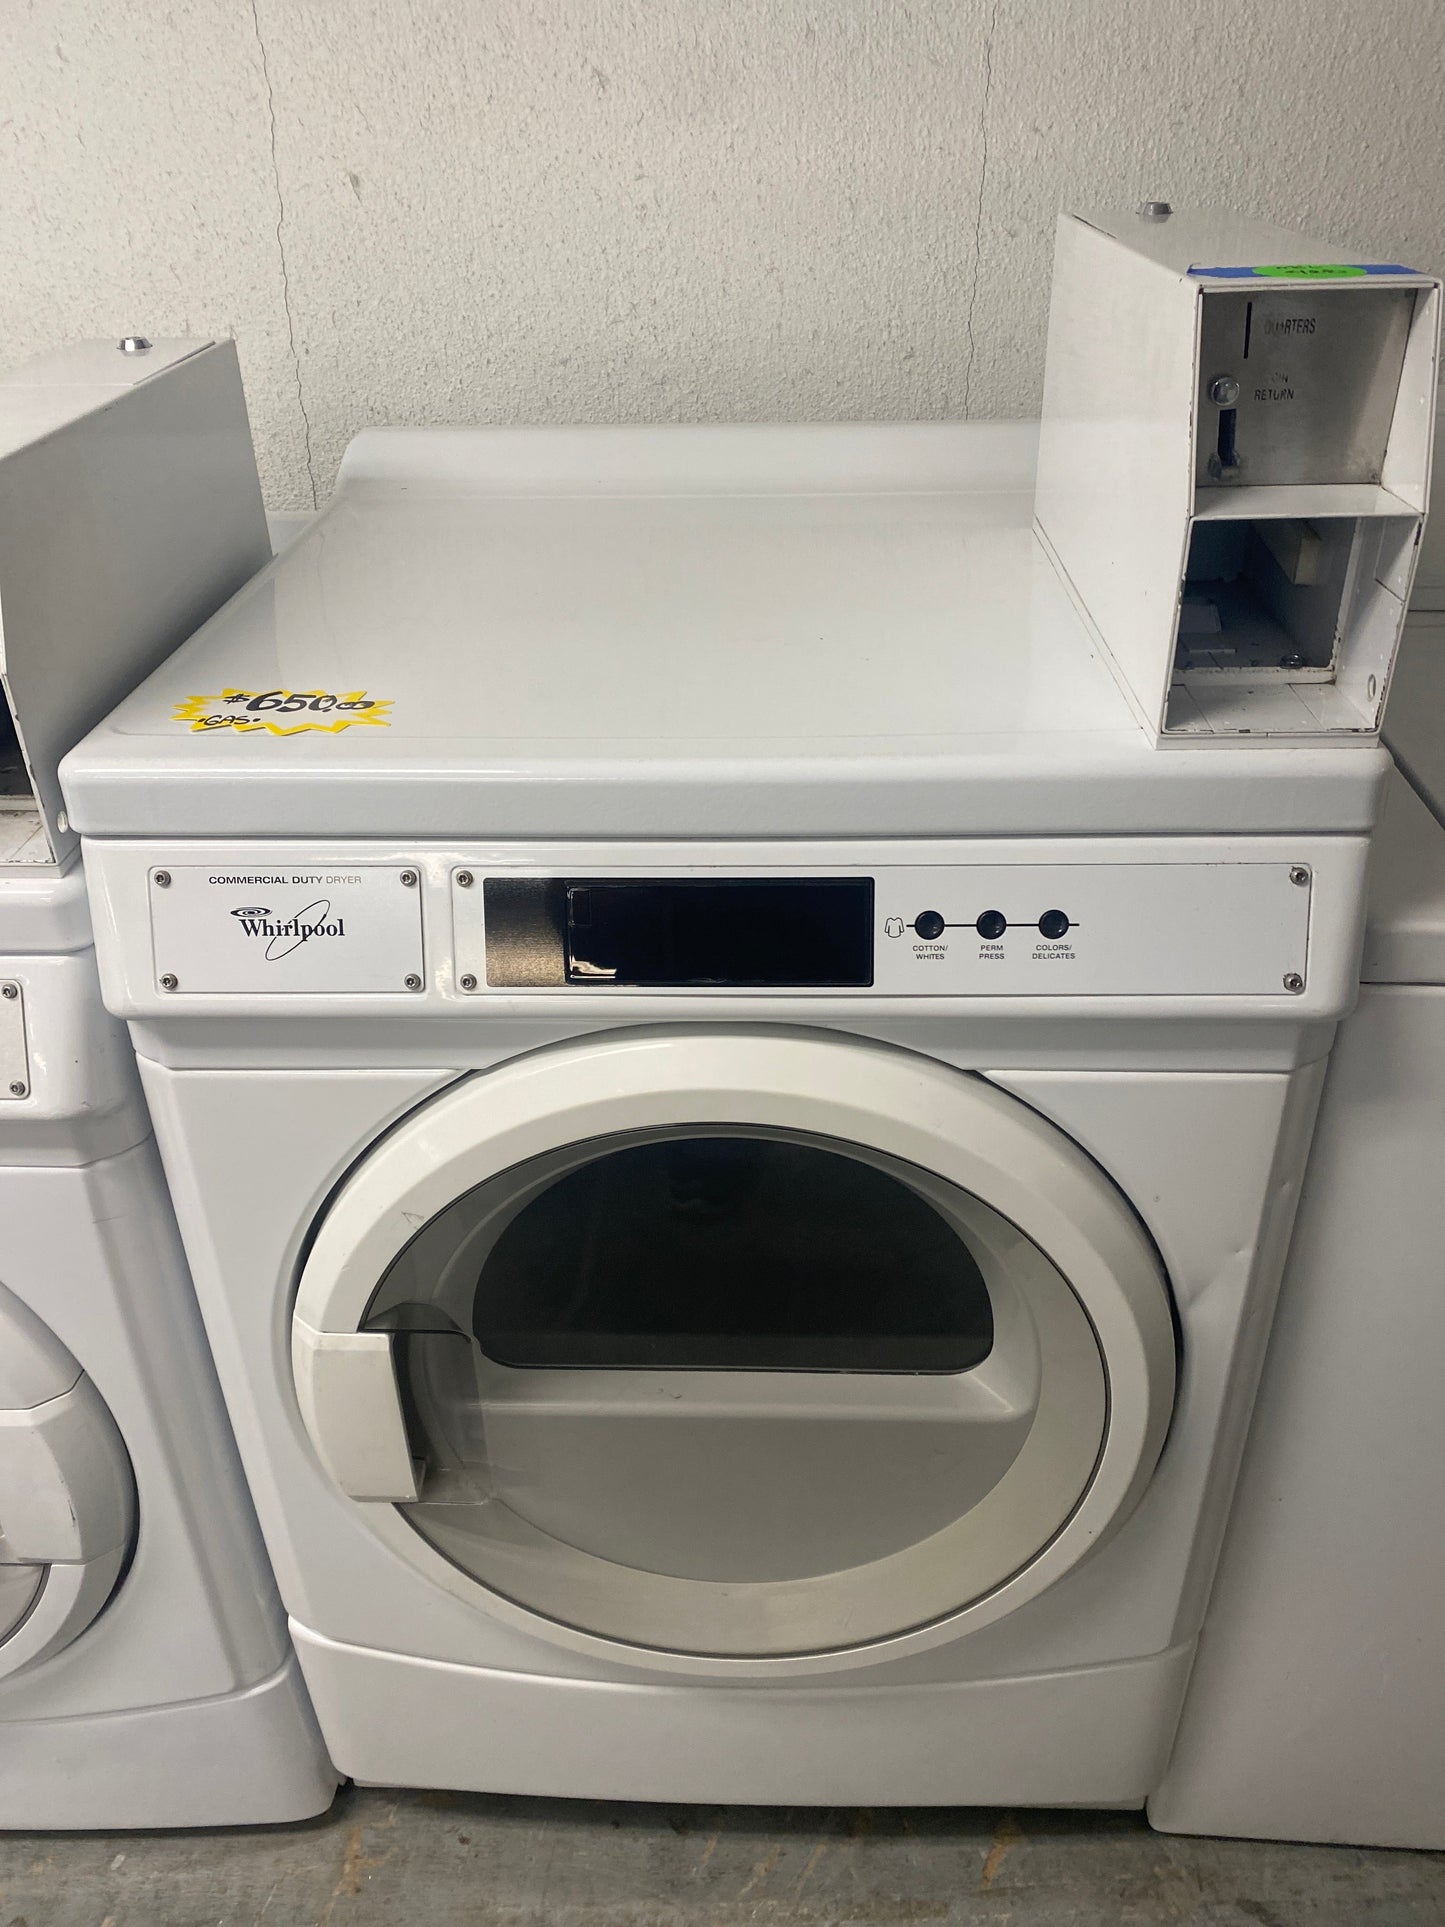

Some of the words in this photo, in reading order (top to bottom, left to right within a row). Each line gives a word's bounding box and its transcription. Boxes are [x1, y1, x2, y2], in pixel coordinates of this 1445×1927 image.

[1264, 318, 1317, 335] RTERS
[1253, 388, 1295, 401] RETURN
[208, 876, 289, 885] COMMERCIAL
[291, 876, 324, 885] DUTY
[325, 875, 362, 885] DRYER
[238, 918, 346, 942] Whirlpool
[980, 944, 1004, 952] PERM
[1035, 944, 1073, 952] COLORS/
[978, 952, 1005, 960] PRESS
[1031, 952, 1076, 960] DELICATES
